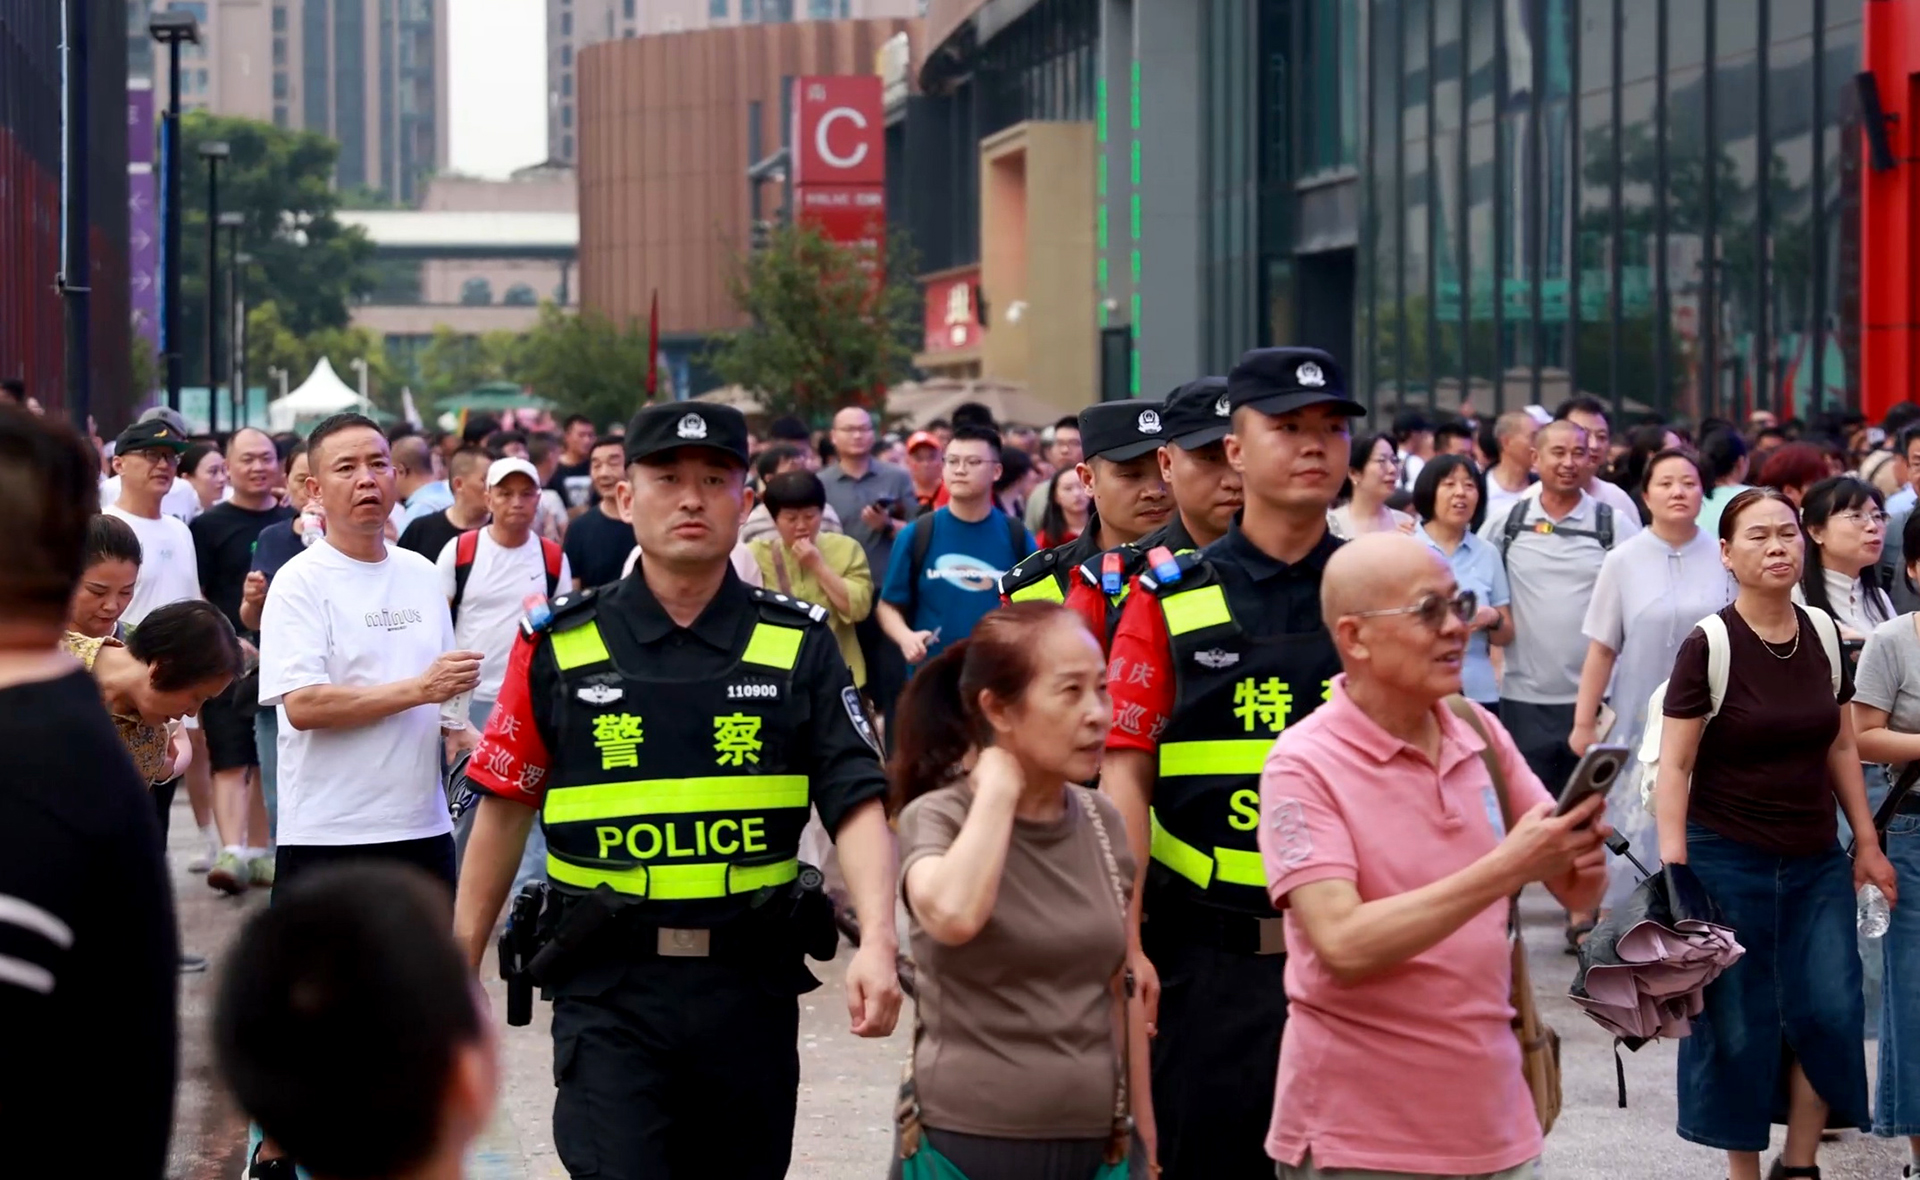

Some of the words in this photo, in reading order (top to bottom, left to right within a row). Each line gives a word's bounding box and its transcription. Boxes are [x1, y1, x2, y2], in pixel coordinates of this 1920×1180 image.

[815, 106, 869, 168] C
[364, 608, 423, 627] minus
[726, 684, 778, 698] 110900
[1233, 676, 1334, 732] 特
[597, 817, 767, 858] POLICE
